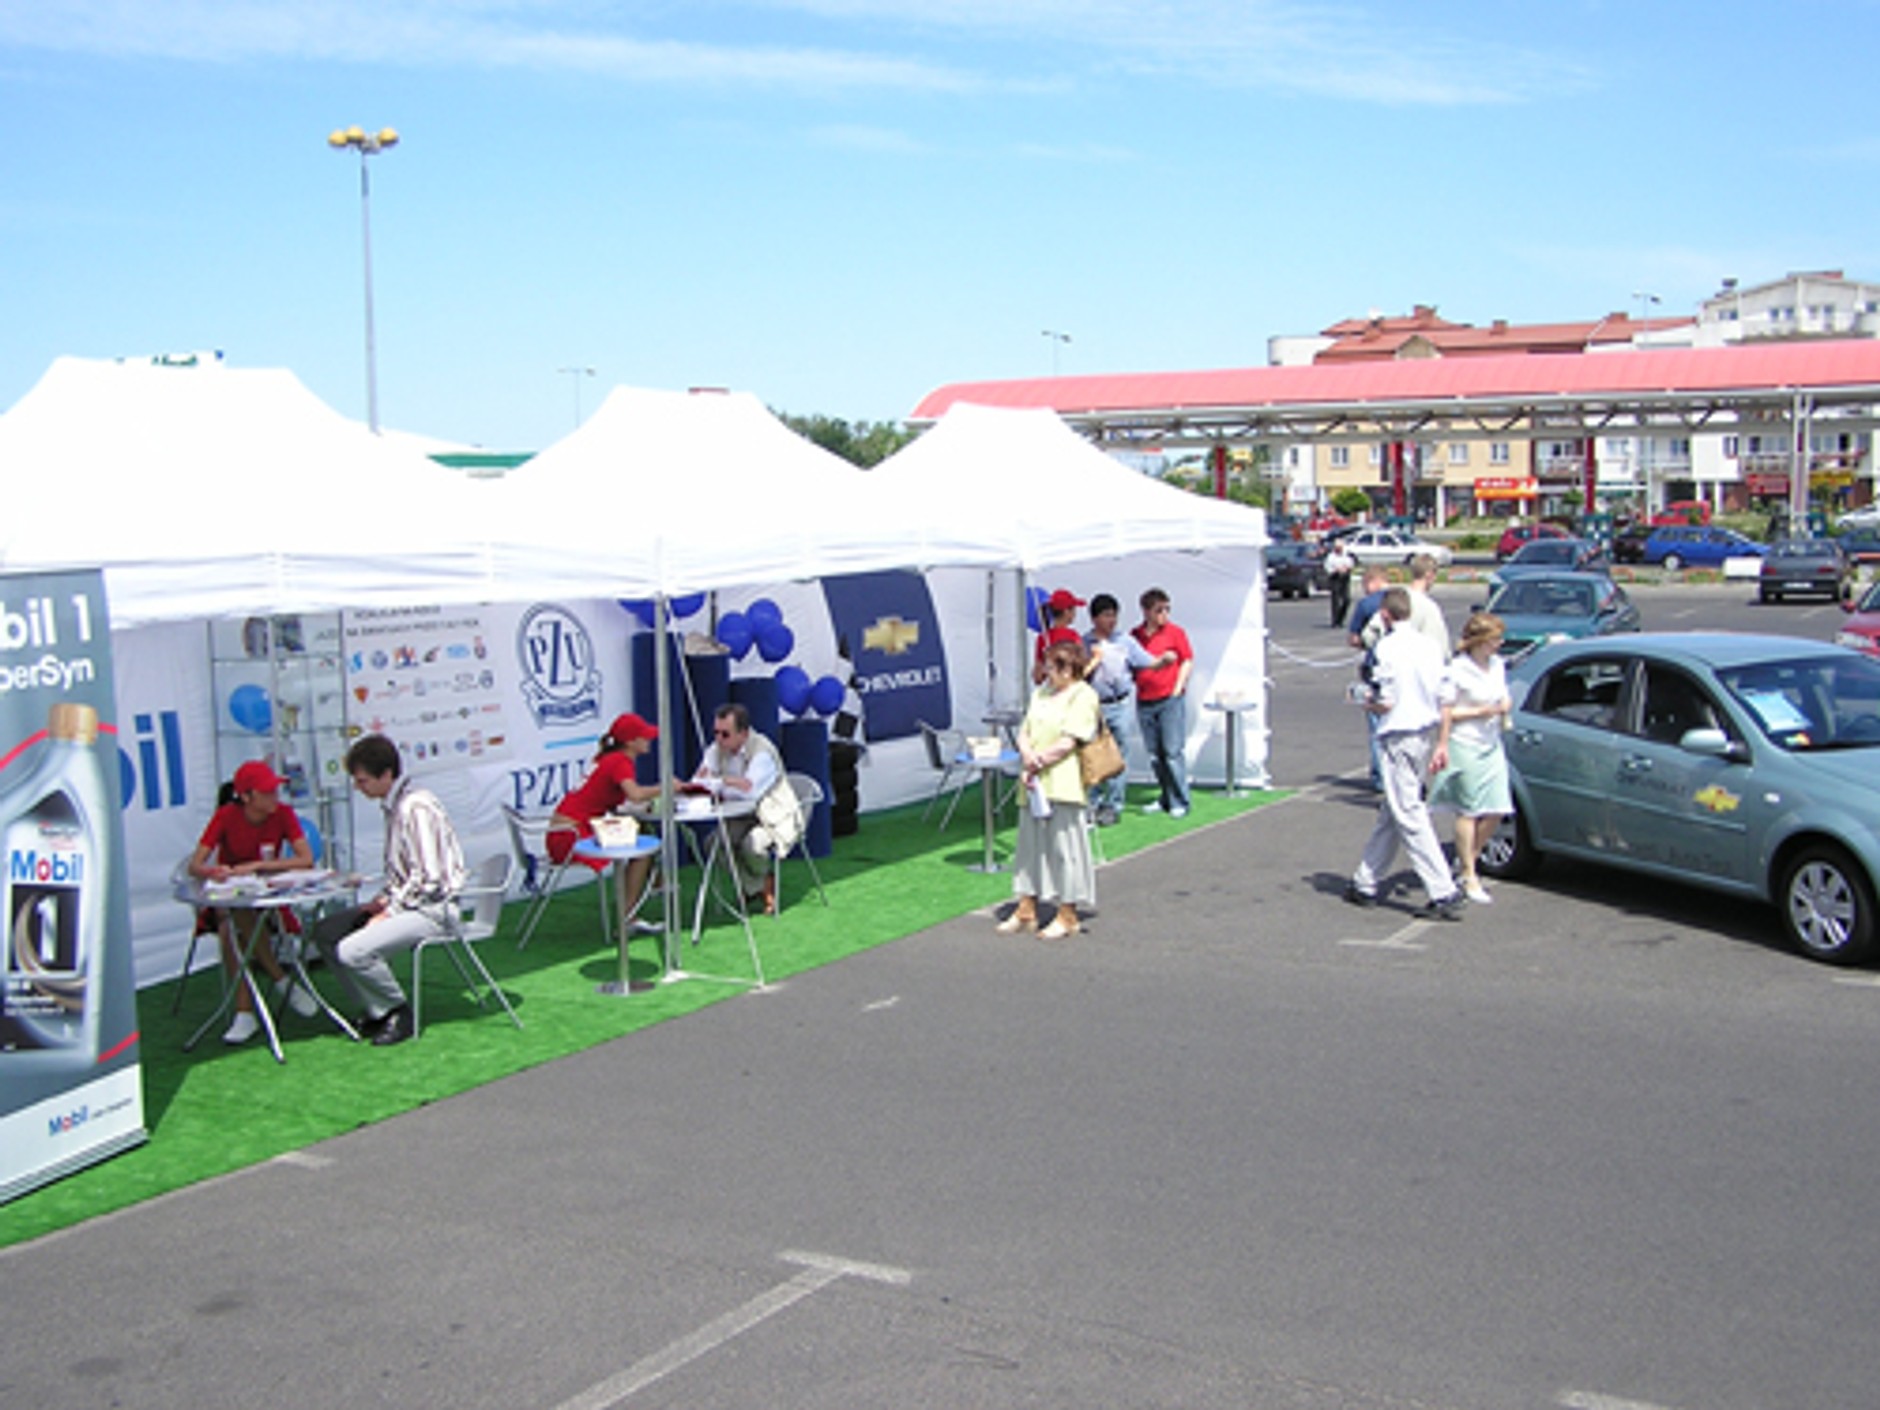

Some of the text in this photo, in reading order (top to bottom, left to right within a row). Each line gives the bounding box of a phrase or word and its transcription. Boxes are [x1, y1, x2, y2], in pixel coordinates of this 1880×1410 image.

[71, 593, 91, 641] 1
[527, 619, 584, 688] PZU
[11, 850, 83, 881] Mobil
[37, 894, 58, 963] 1
[49, 1104, 88, 1137] Mobil
